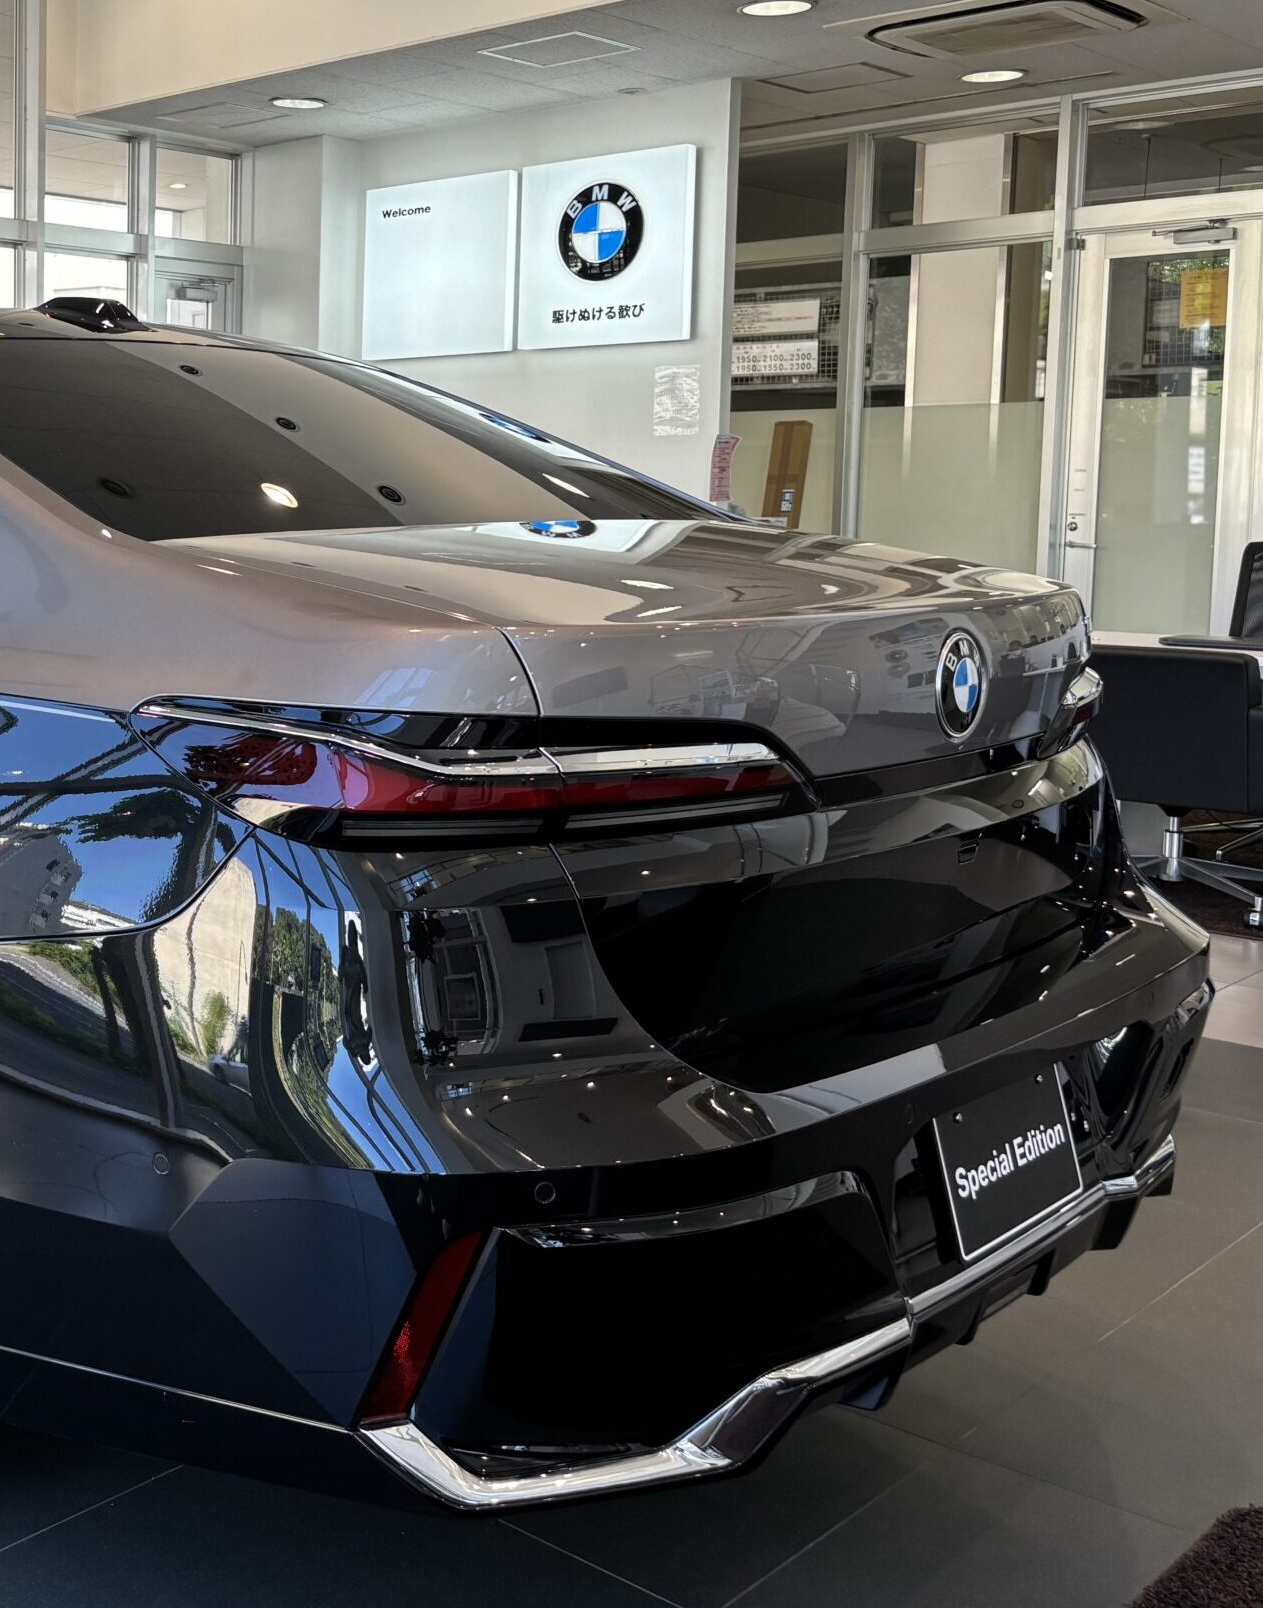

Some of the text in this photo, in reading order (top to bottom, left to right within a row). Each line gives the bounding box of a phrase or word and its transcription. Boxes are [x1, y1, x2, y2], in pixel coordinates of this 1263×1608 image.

[382, 206, 431, 219] Welcome
[567, 184, 637, 219] BMW
[552, 303, 645, 324] 駆けぬける歓び
[955, 1123, 1065, 1199] Special Edition
